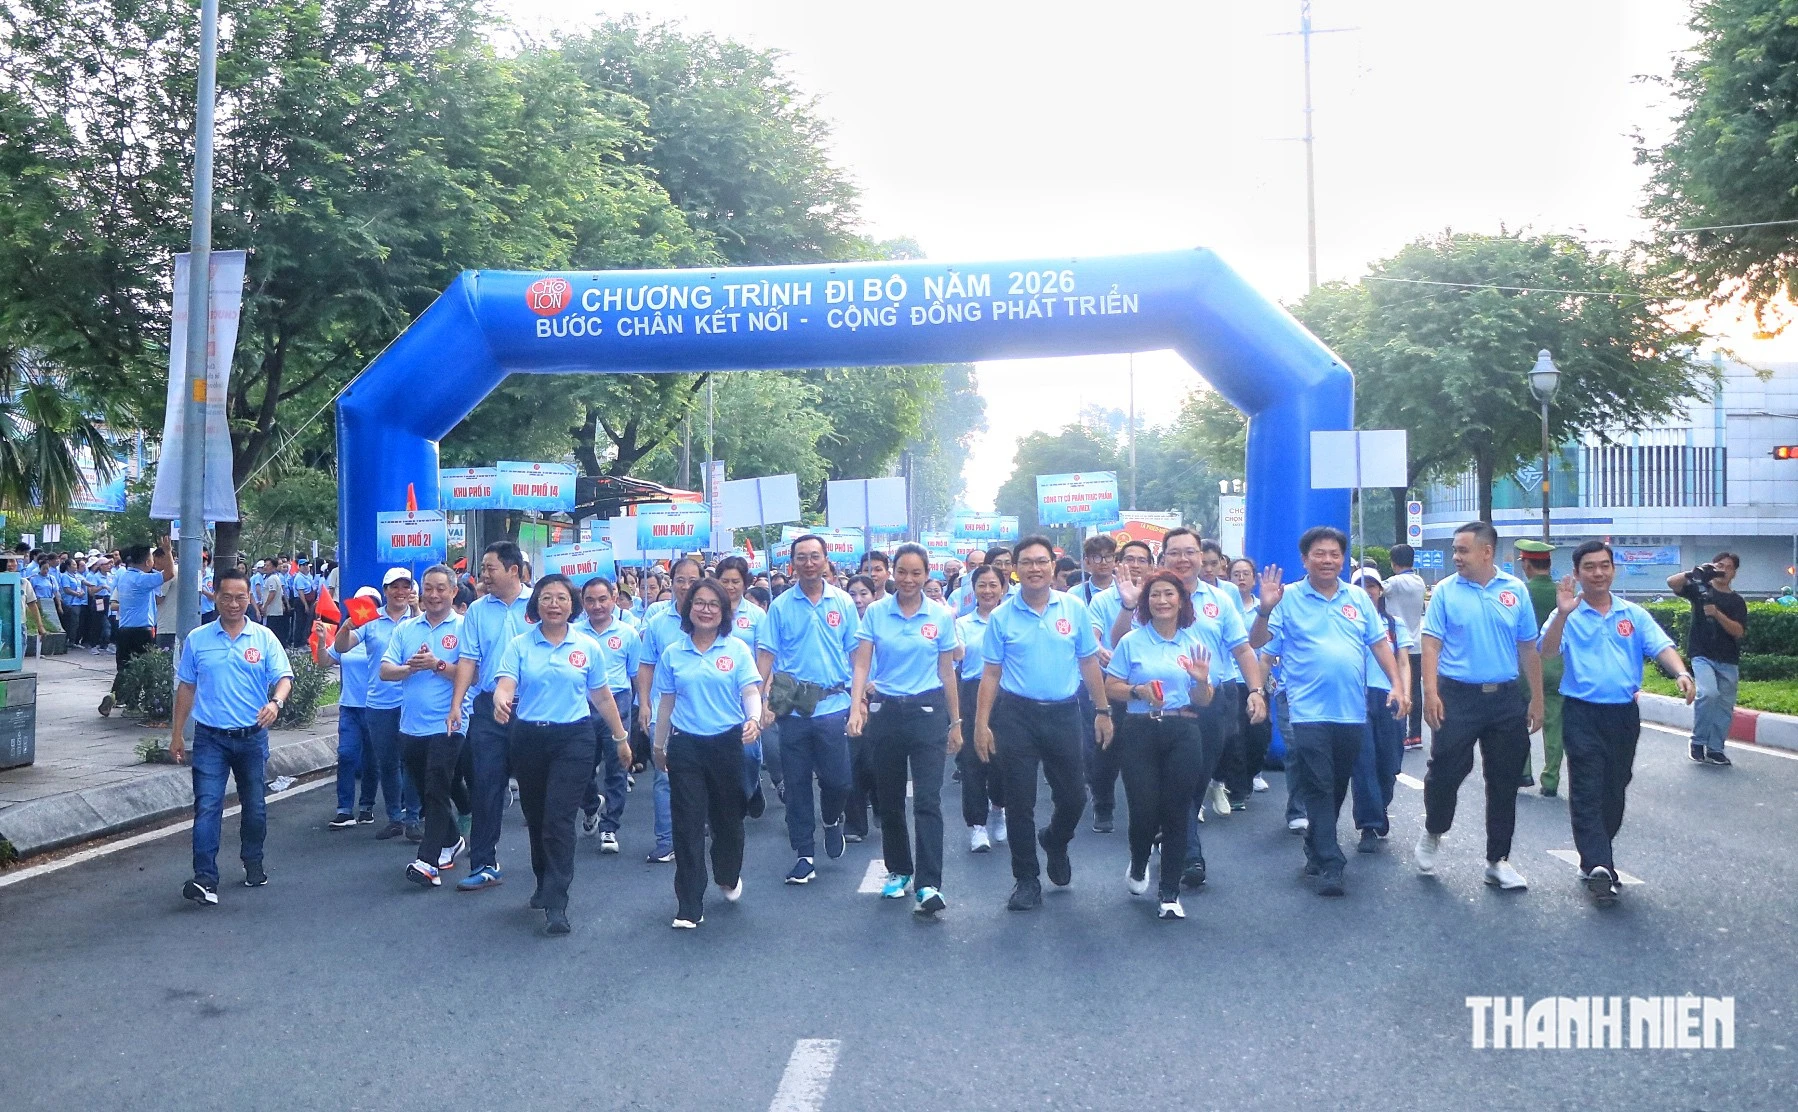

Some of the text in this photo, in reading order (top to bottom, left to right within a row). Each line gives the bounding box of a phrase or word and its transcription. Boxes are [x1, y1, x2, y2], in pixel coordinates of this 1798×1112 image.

[582, 269, 1075, 312] CHƯƠNG TRÌNH ĐI BỘ NĂM 2026
[536, 313, 602, 338] BƯỚC
[617, 312, 683, 337] CHÂN
[695, 305, 741, 334] KẾT
[749, 304, 788, 332] NỐI
[827, 304, 897, 332] CỘNG
[909, 299, 982, 326] ĐỒNG
[992, 294, 1057, 321] PHÁT
[1063, 283, 1139, 316] TRIỂN
[453, 483, 491, 498] KHU PHỐ 16
[512, 481, 558, 497] KHU PHỐ 14
[653, 521, 694, 537] KHU PHỐ 17
[391, 529, 431, 548] KHU PHỐ 21
[561, 558, 598, 576] KHU PHỐ 7
